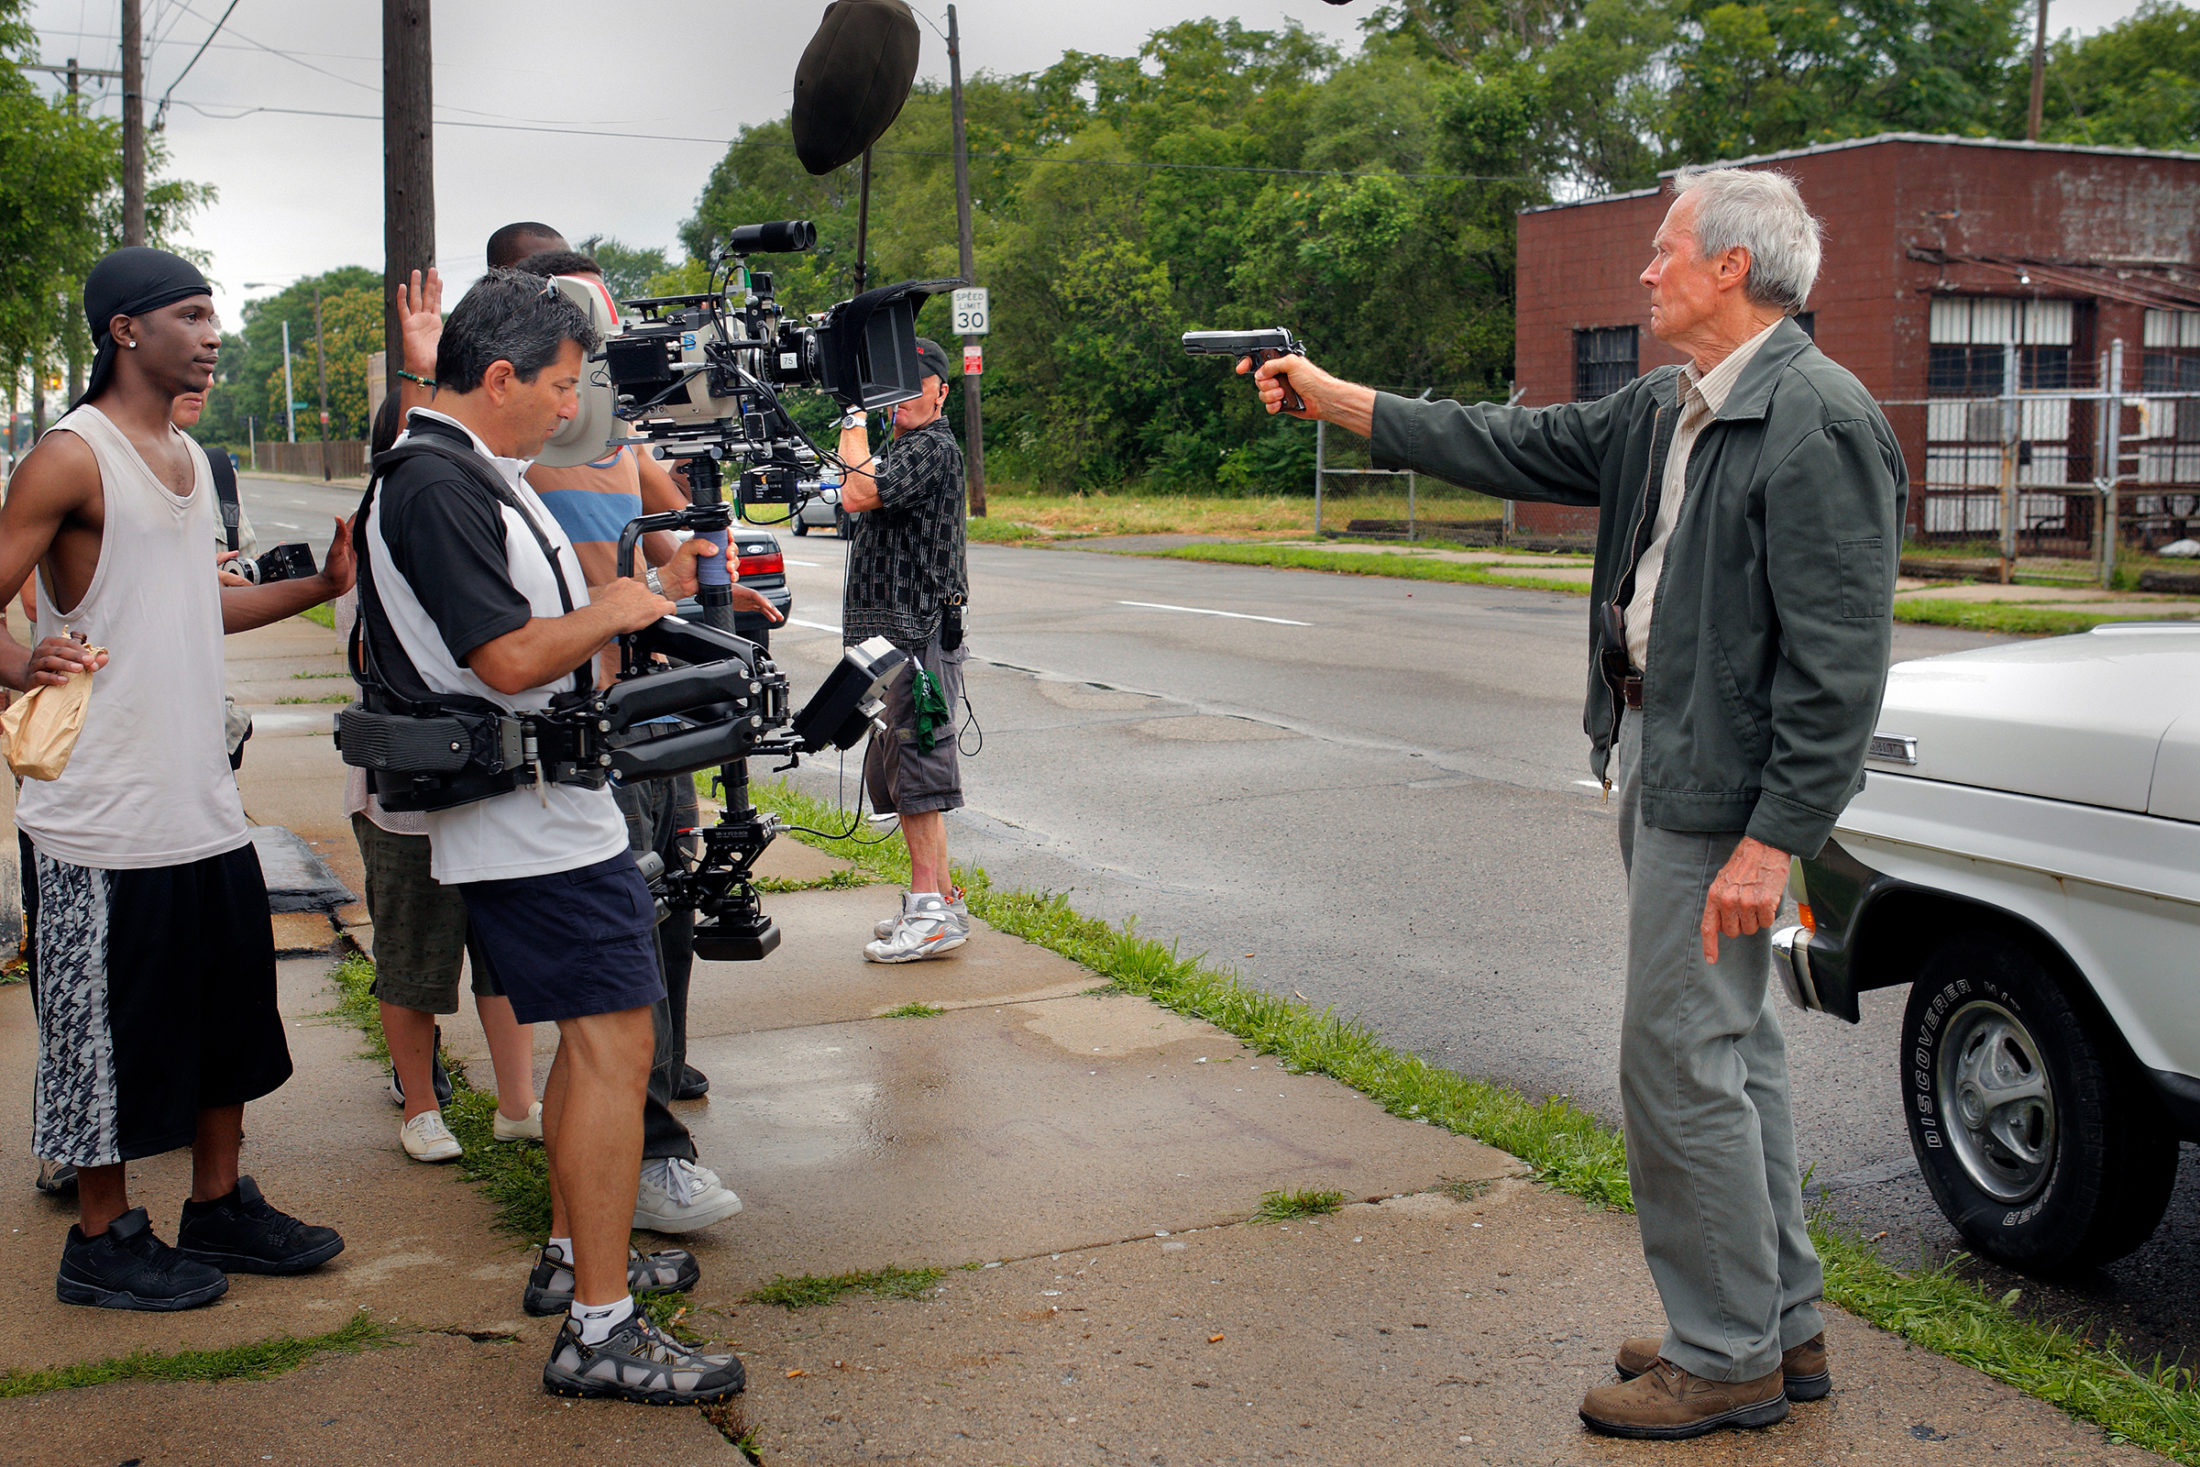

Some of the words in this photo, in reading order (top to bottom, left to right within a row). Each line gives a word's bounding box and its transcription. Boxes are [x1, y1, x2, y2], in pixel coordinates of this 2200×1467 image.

[956, 292, 984, 301] SPEED
[958, 312, 984, 328] 30
[783, 357, 793, 365] 75
[1915, 978, 1972, 1148] DISCOVERER
